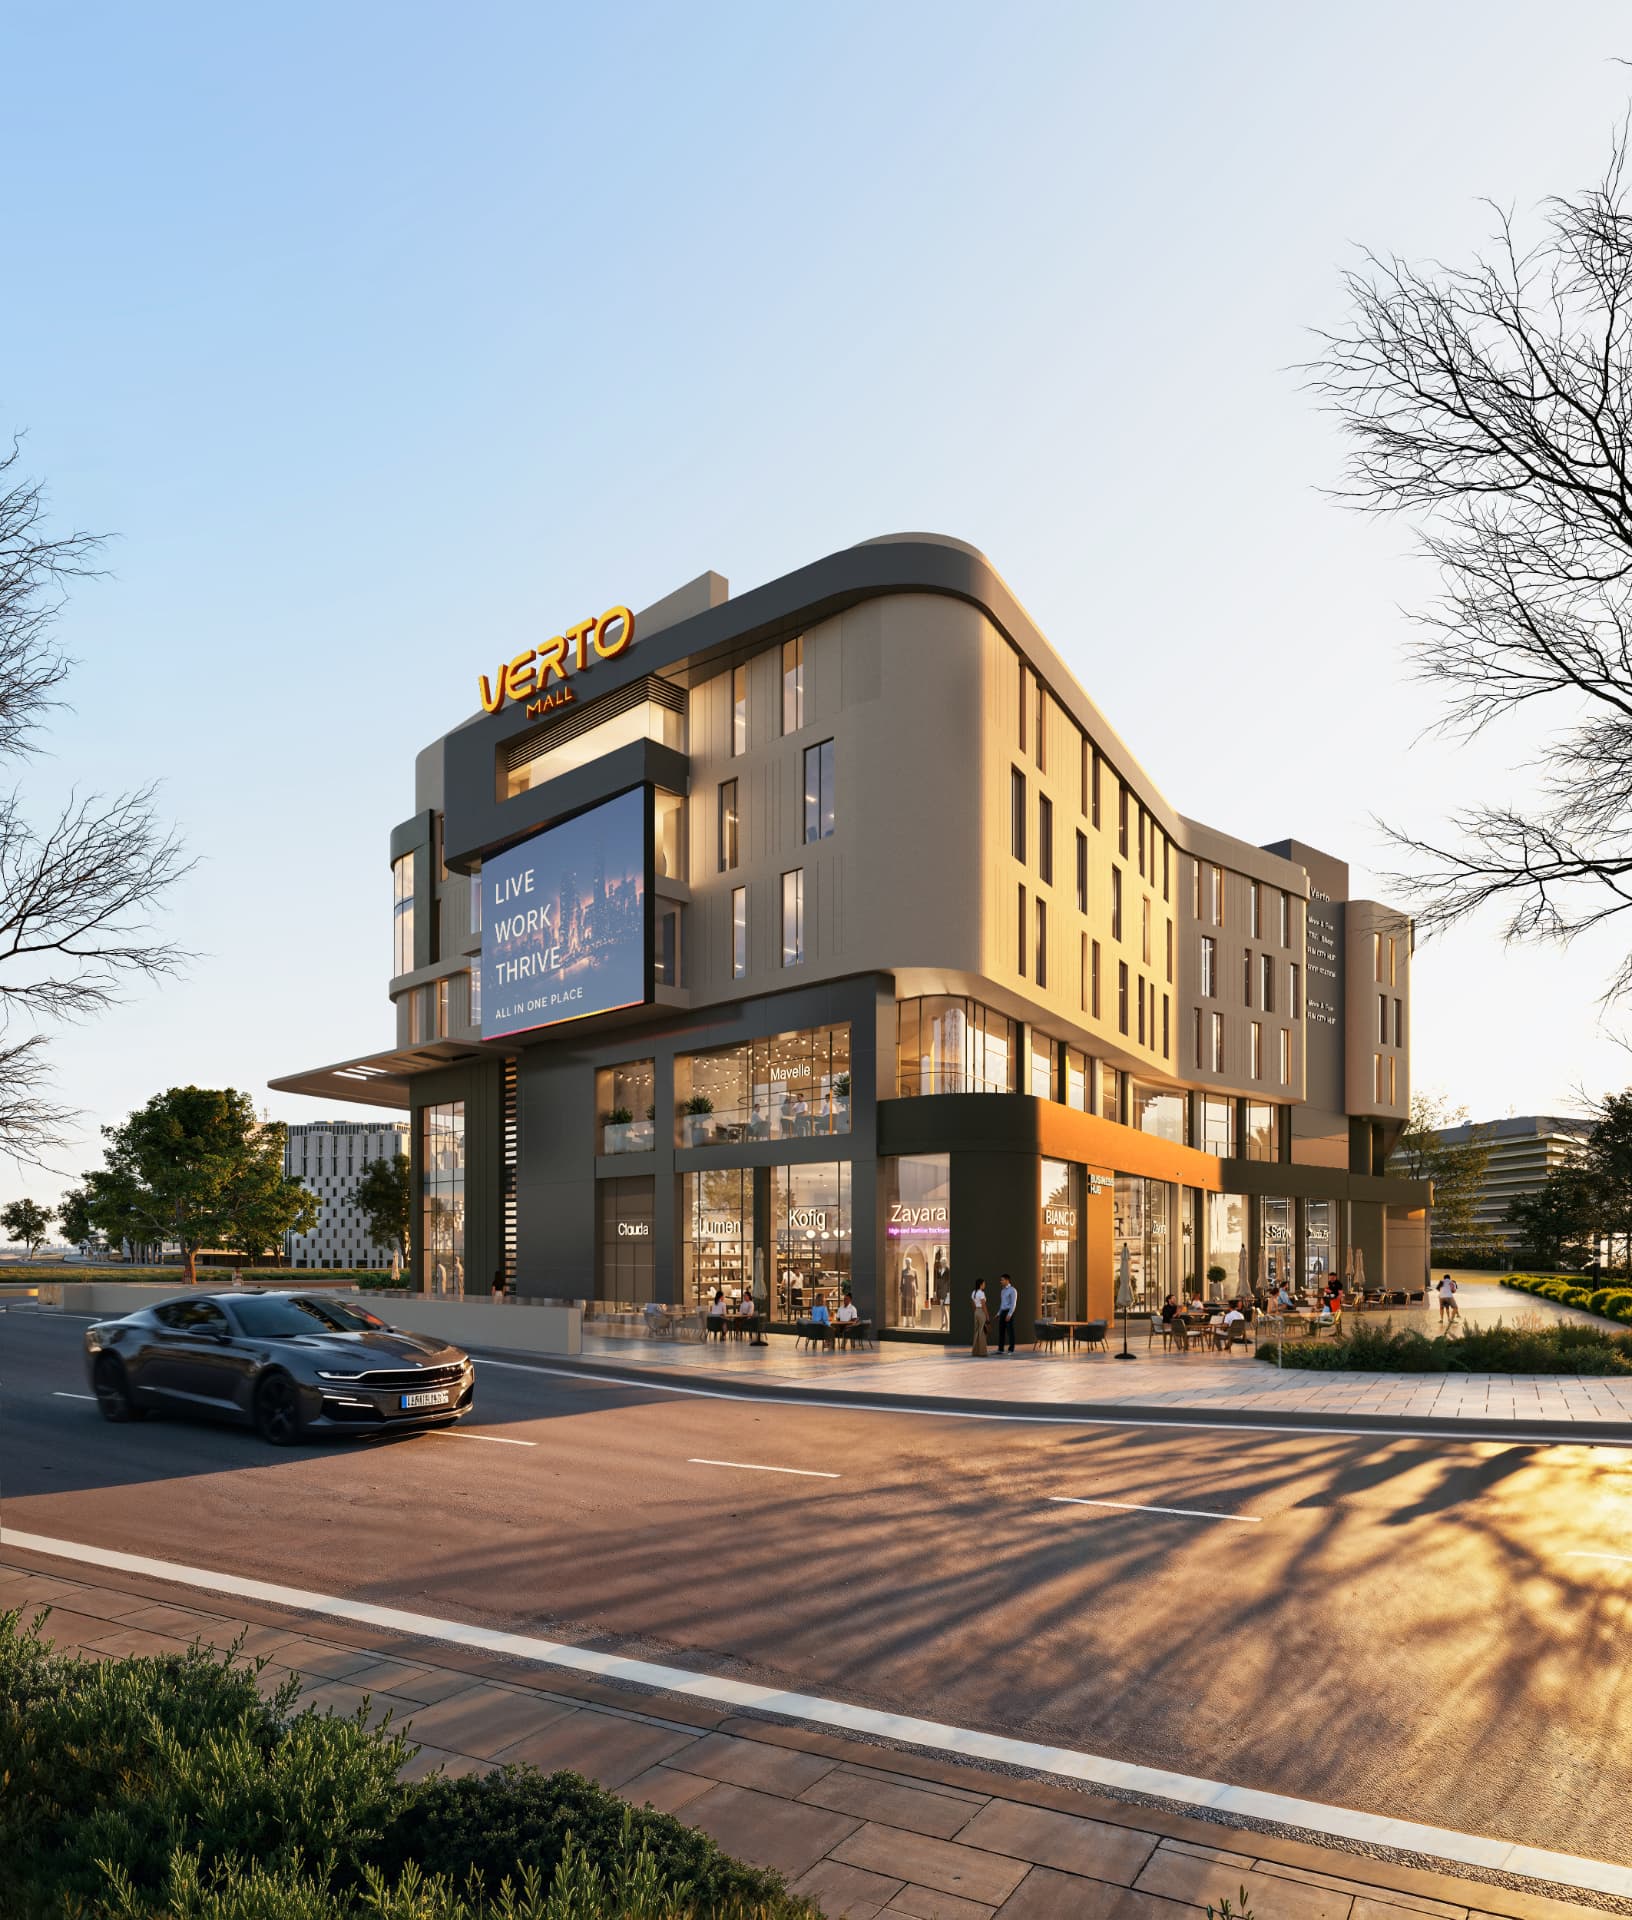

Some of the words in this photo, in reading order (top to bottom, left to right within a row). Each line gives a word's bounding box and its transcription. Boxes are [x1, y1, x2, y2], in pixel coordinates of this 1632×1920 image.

[478, 605, 635, 714] VERTO
[526, 686, 575, 720] MALL
[495, 869, 535, 904] LIVE
[495, 904, 552, 944] WORK
[495, 946, 561, 985] THRIVE
[495, 1007, 512, 1020] ALL
[514, 1003, 524, 1016] IN
[527, 997, 548, 1012] ONE
[551, 987, 583, 1006] PLACE
[770, 1064, 811, 1081] Mavelle
[789, 1208, 826, 1231] Kofig
[891, 1204, 947, 1226] Zayara
[1046, 1209, 1075, 1226] BIANCO
